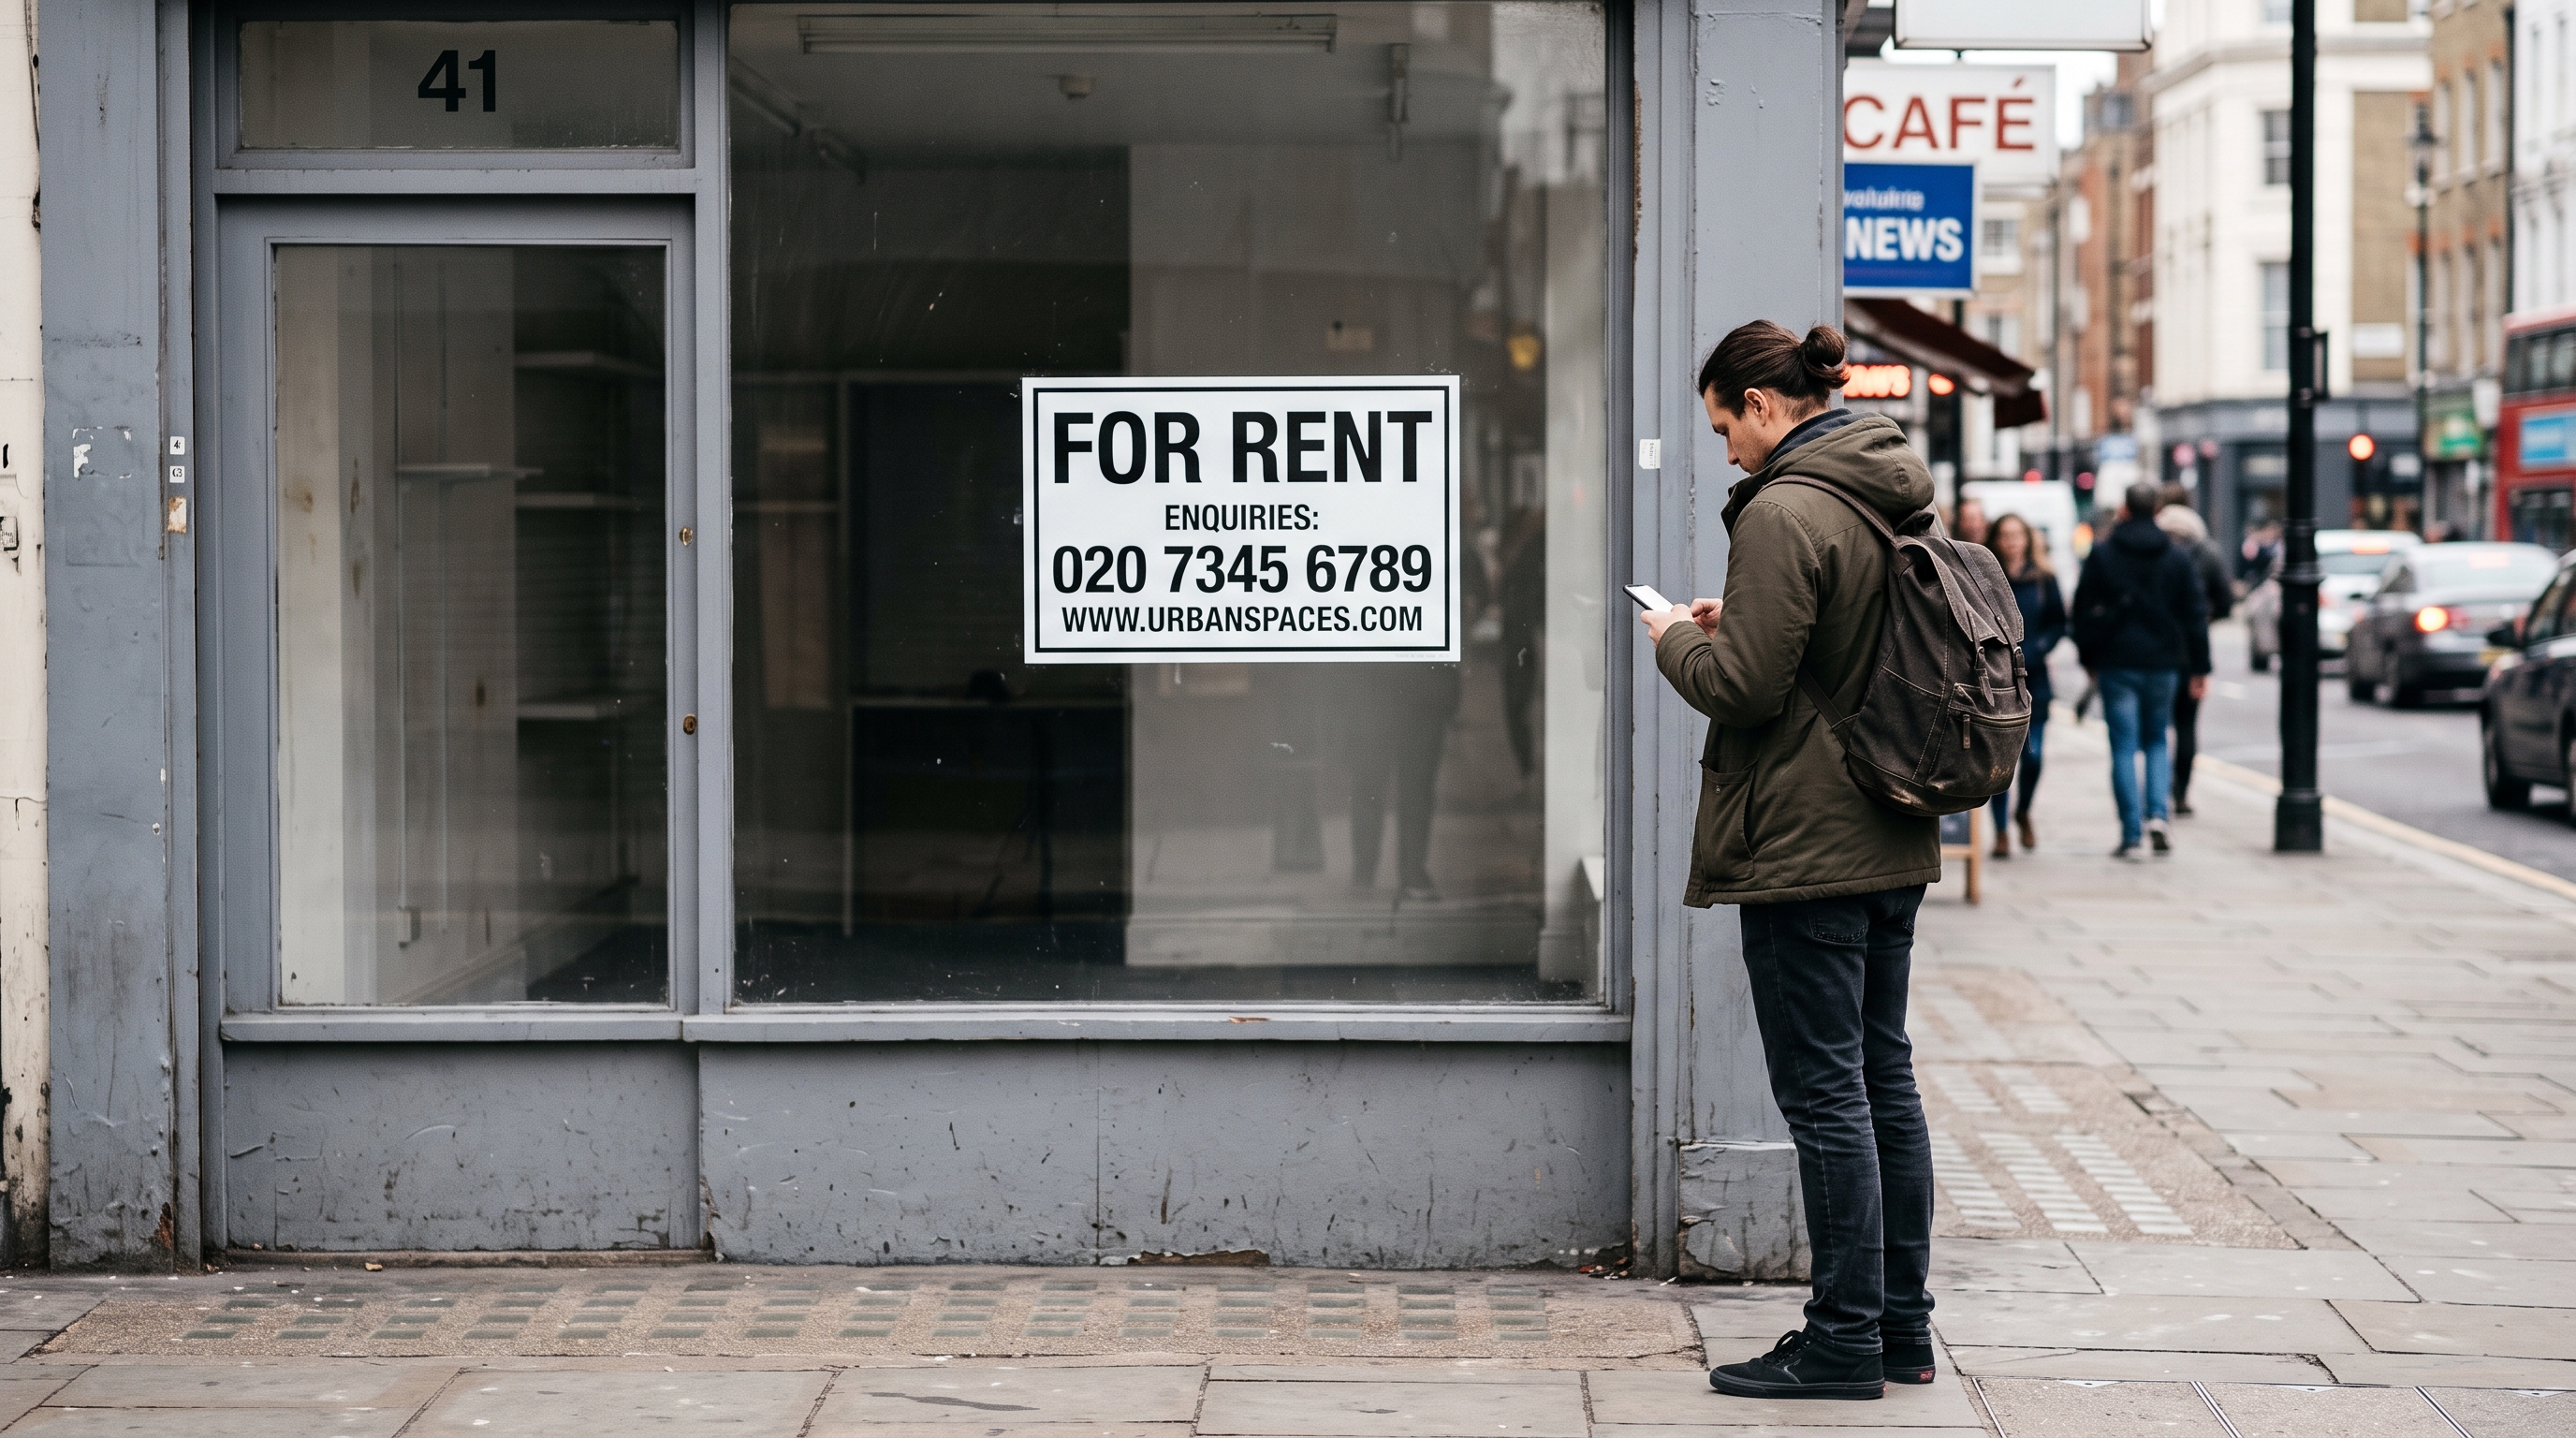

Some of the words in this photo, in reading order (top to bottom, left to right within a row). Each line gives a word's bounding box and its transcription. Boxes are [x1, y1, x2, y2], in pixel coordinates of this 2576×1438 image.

[417, 50, 496, 112] 41
[1844, 77, 2035, 152] CAFÉ
[1846, 216, 1965, 263] NEWS
[1053, 410, 1203, 485] FOR
[1232, 410, 1433, 483] RENT
[1164, 504, 1319, 533] ENQUIRIES:
[1052, 546, 1147, 594] 020
[1164, 544, 1289, 593] 7345
[1306, 544, 1432, 593] 6789
[1061, 606, 1424, 633] WWW.URBANSPACES.COM
